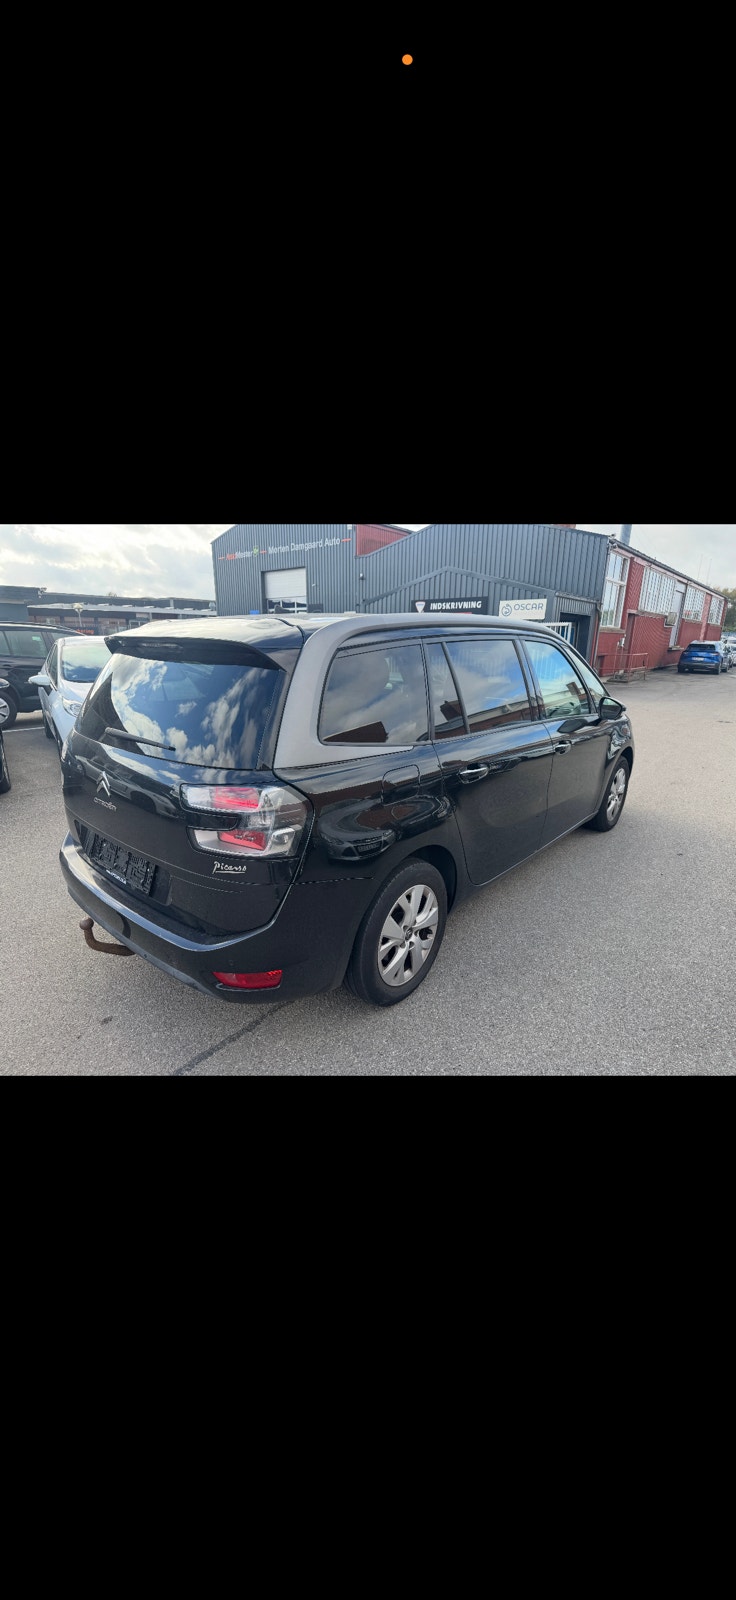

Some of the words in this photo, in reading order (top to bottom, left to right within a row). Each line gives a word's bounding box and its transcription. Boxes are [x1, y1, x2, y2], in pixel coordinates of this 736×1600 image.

[268, 545, 289, 554] Morten
[290, 542, 323, 552] Damgaard
[324, 537, 341, 547] Auto
[430, 601, 482, 610] INDSKRIVNING
[513, 603, 544, 611] OSCAR
